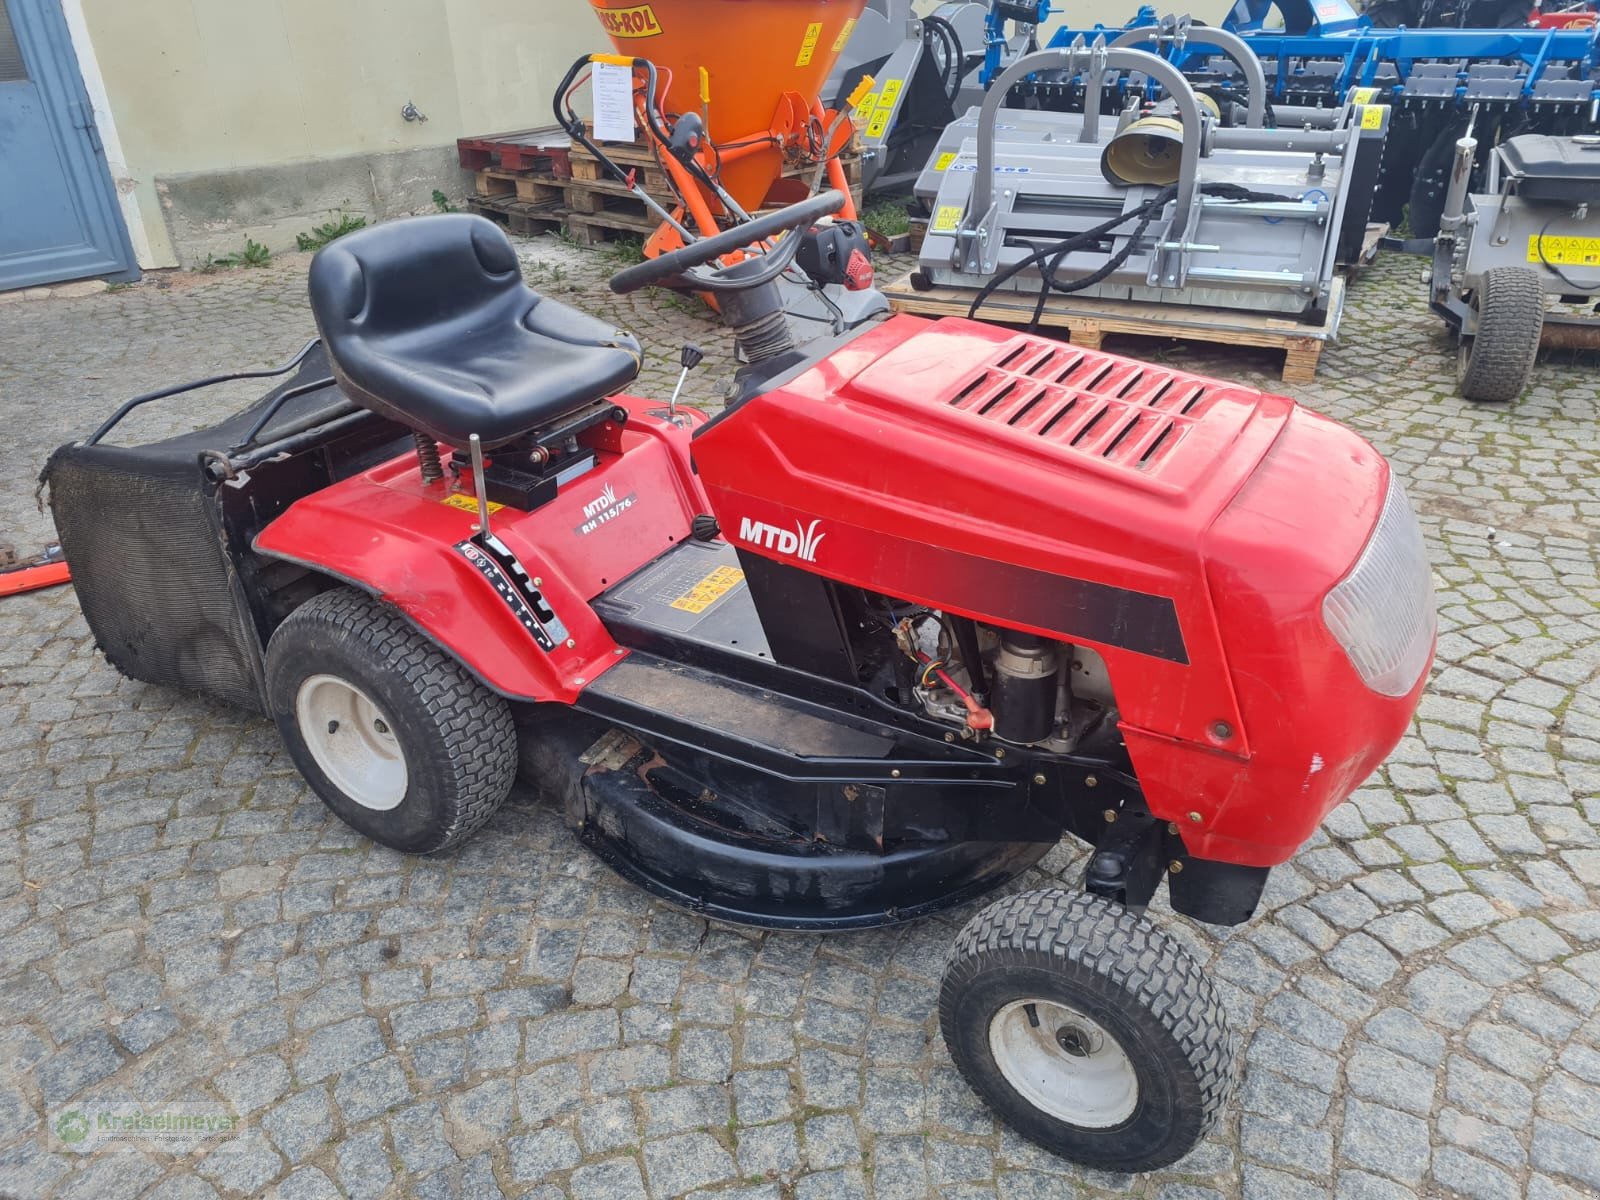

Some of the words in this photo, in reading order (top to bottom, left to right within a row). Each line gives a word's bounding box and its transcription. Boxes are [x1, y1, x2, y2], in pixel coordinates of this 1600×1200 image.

[581, 519, 597, 535] RH
[598, 498, 632, 524] 115/76
[583, 495, 609, 519] MTD
[739, 516, 799, 555] MTD
